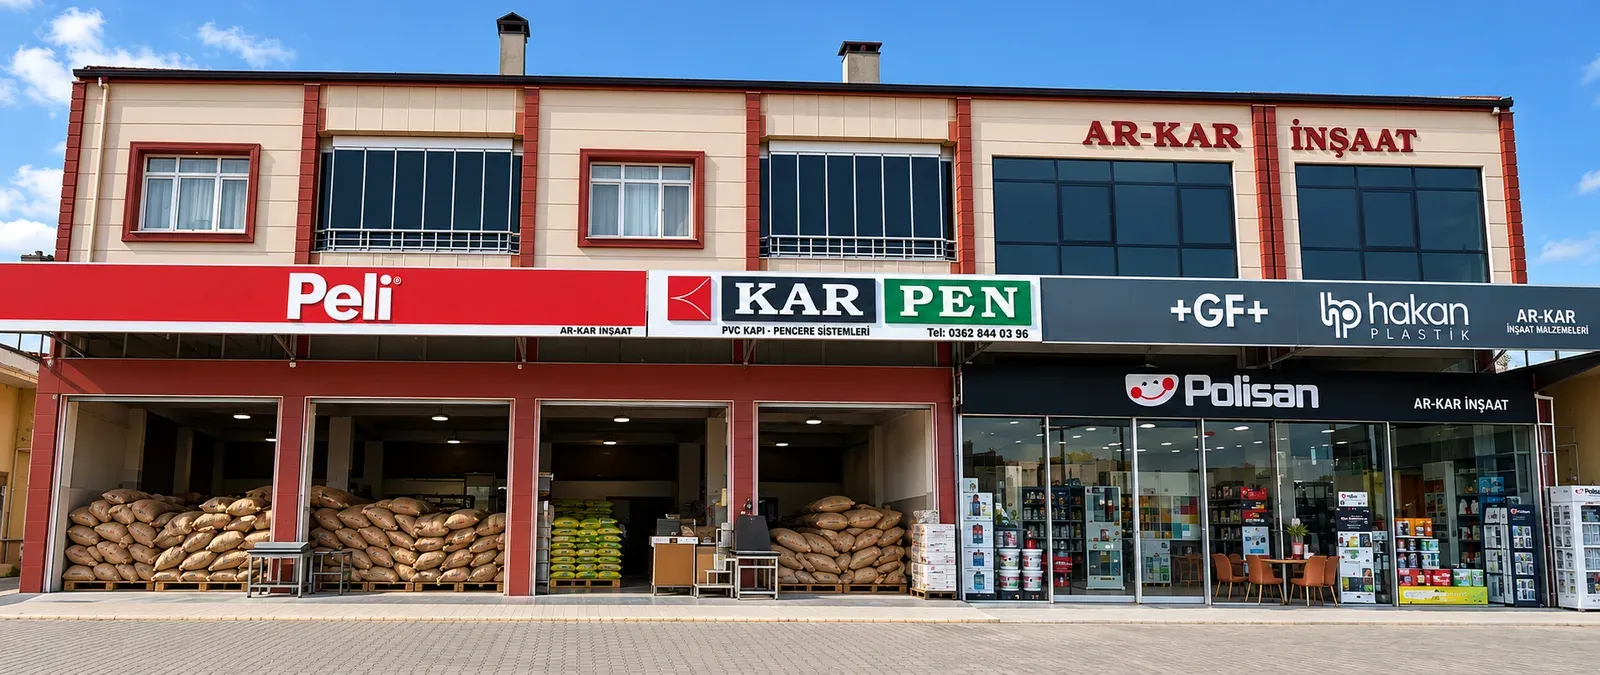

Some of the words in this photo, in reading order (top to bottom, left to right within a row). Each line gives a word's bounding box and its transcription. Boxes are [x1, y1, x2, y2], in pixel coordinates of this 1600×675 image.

[1082, 119, 1241, 149] AR-KAR
[1291, 118, 1417, 158] İNŞAAT
[733, 282, 864, 317] KAR
[900, 285, 1018, 319] PEN
[1367, 292, 1470, 326] hakan
[1516, 308, 1577, 324] AR-KAR
[560, 326, 596, 335] AR-KAR
[599, 326, 633, 336] İNŞAAT
[721, 325, 741, 335] PVC
[743, 326, 765, 335] KAPI
[773, 326, 815, 336] PENCERE
[817, 324, 870, 337] SİSTEMLERİ
[927, 327, 946, 338] Tel:
[948, 328, 974, 338] 0362
[976, 328, 997, 339] 844
[999, 328, 1013, 339] 03
[1015, 329, 1029, 339] 96
[1370, 327, 1470, 341] PLASTİK
[1506, 322, 1535, 336] İNŞAAT
[1536, 324, 1589, 335] MALZEMELERİ
[1184, 374, 1320, 409] Polisan
[1413, 397, 1462, 411] AR-KAR
[1464, 395, 1509, 414] İNŞAAT
